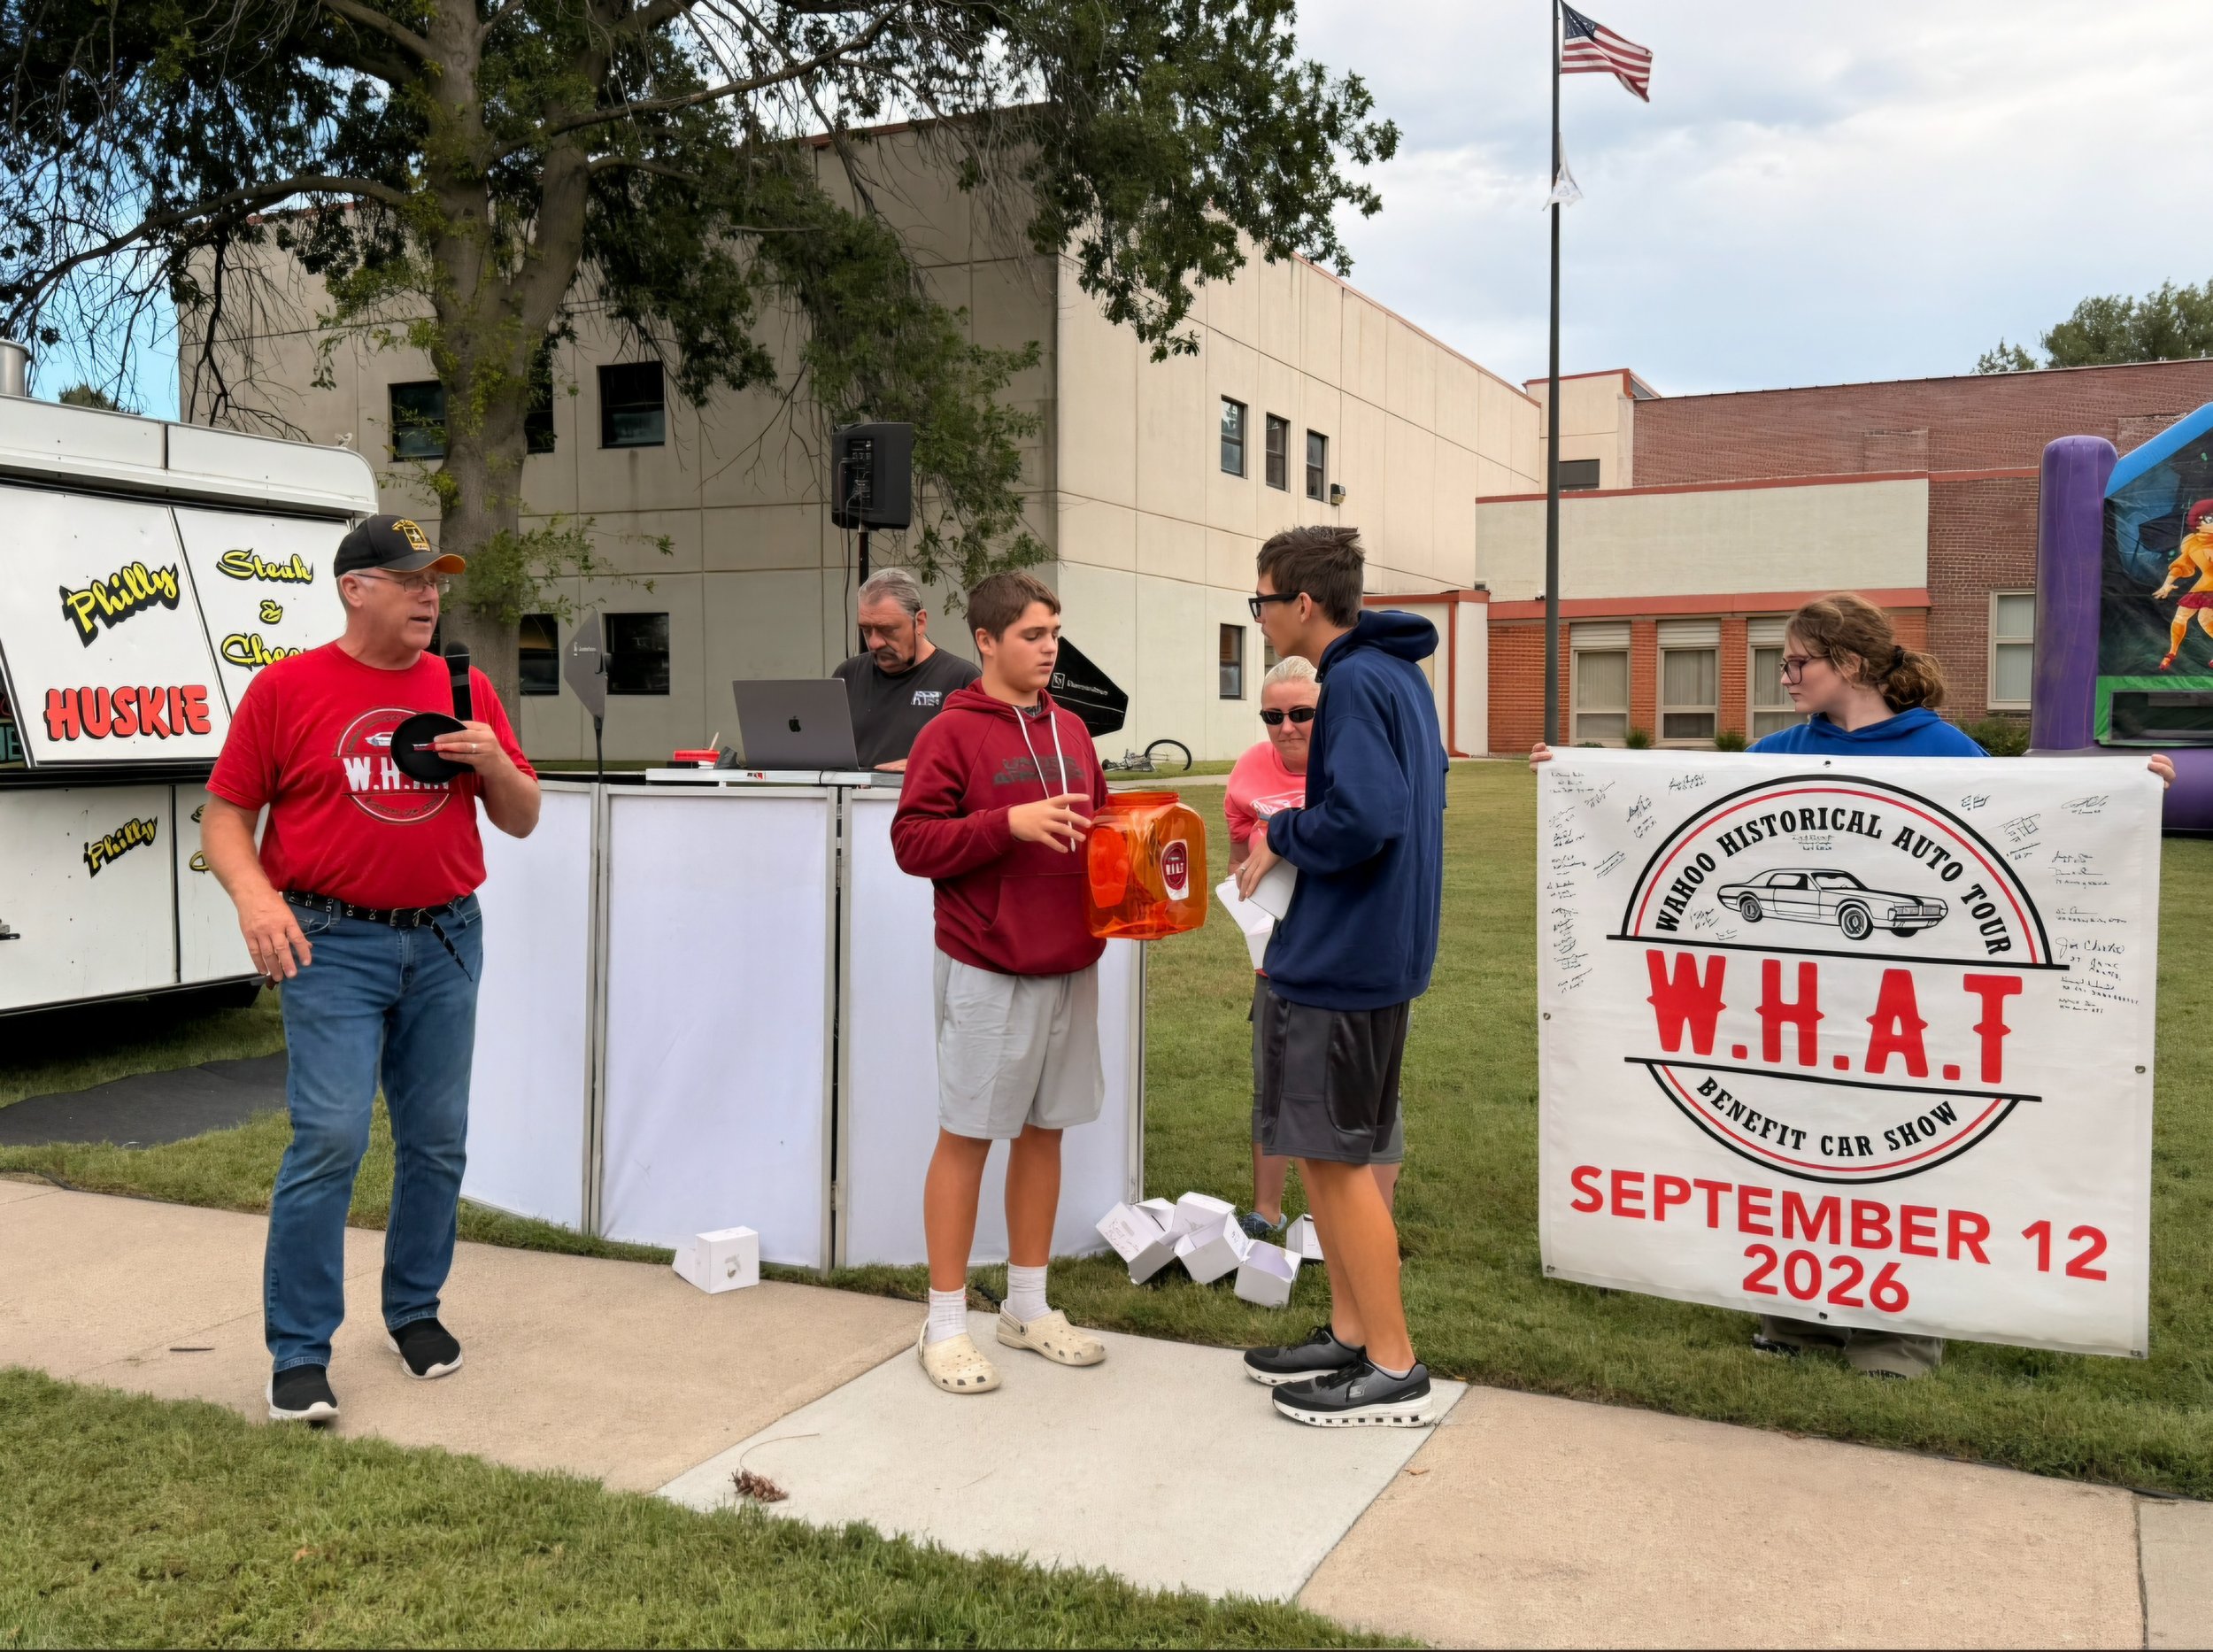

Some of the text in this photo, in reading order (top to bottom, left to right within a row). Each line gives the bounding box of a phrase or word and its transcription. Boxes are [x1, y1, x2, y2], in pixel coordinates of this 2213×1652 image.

[216, 548, 313, 584] Steak
[60, 561, 180, 647] Philly
[259, 599, 282, 624] &
[45, 685, 212, 740] HUSKIE
[83, 815, 158, 877] Philly
[1655, 853, 1716, 932] WAHOO
[1716, 807, 1883, 858] HISTORICAL
[1891, 825, 1963, 882] AUTO
[1960, 883, 2012, 955] TOUR
[1646, 950, 2023, 1085] W.H.A.T
[1696, 1076, 1958, 1157] BENEFIT CAR SHOW
[1570, 1165, 2109, 1282] SEPTEMBER 12
[1742, 1244, 1910, 1314] 2026
